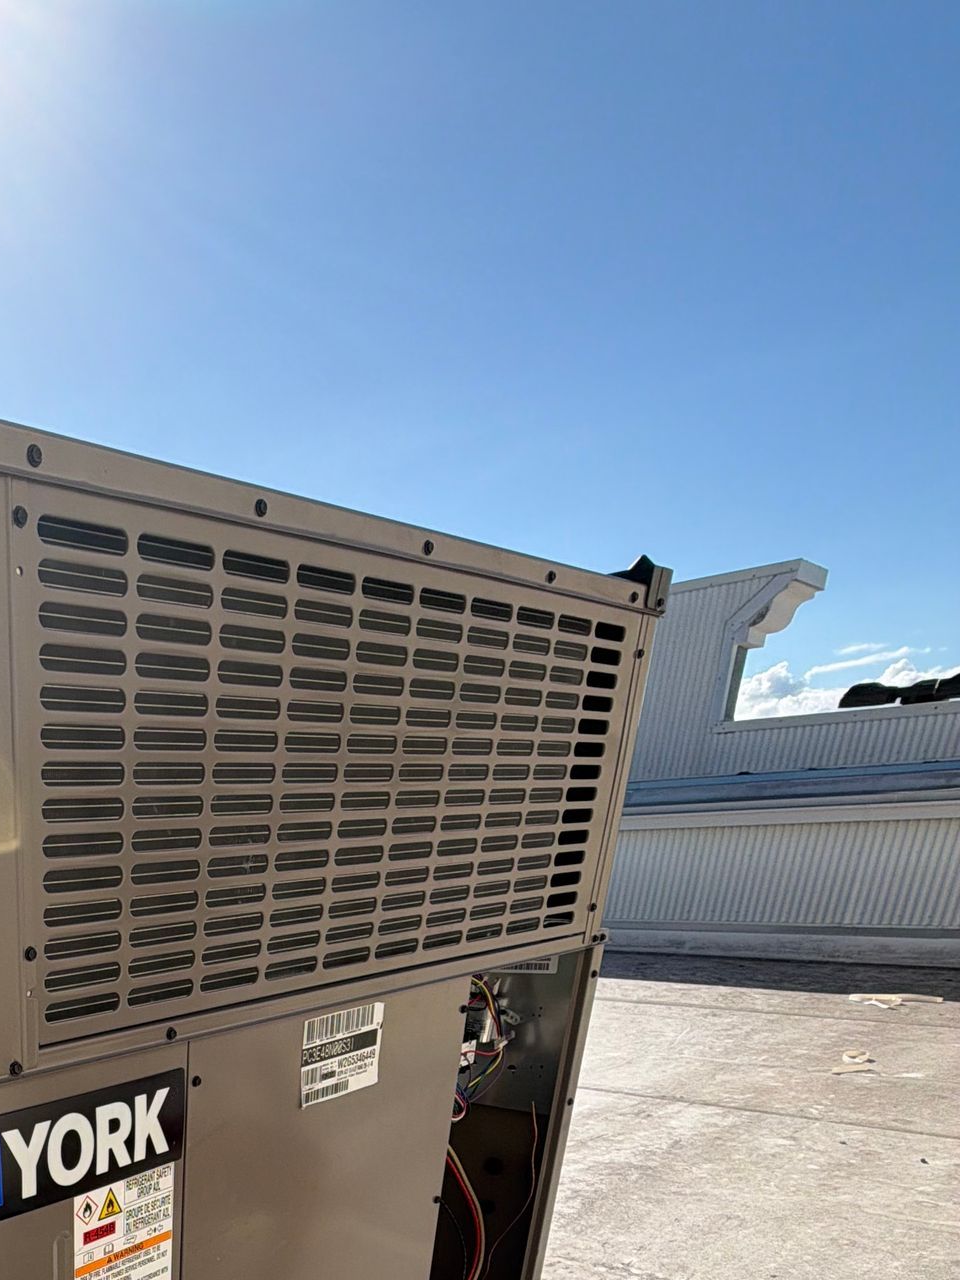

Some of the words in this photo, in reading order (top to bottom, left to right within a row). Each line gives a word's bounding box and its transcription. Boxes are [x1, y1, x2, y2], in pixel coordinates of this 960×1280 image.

[1, 1087, 170, 1200] YORK
[126, 1170, 155, 1191] REFRIGERANT
[156, 1165, 171, 1180] SAFETY
[137, 1183, 152, 1198] GROUP
[125, 1204, 143, 1220] GROUPE
[84, 1223, 114, 1243] R-454B
[114, 1242, 143, 1261] WARNING
